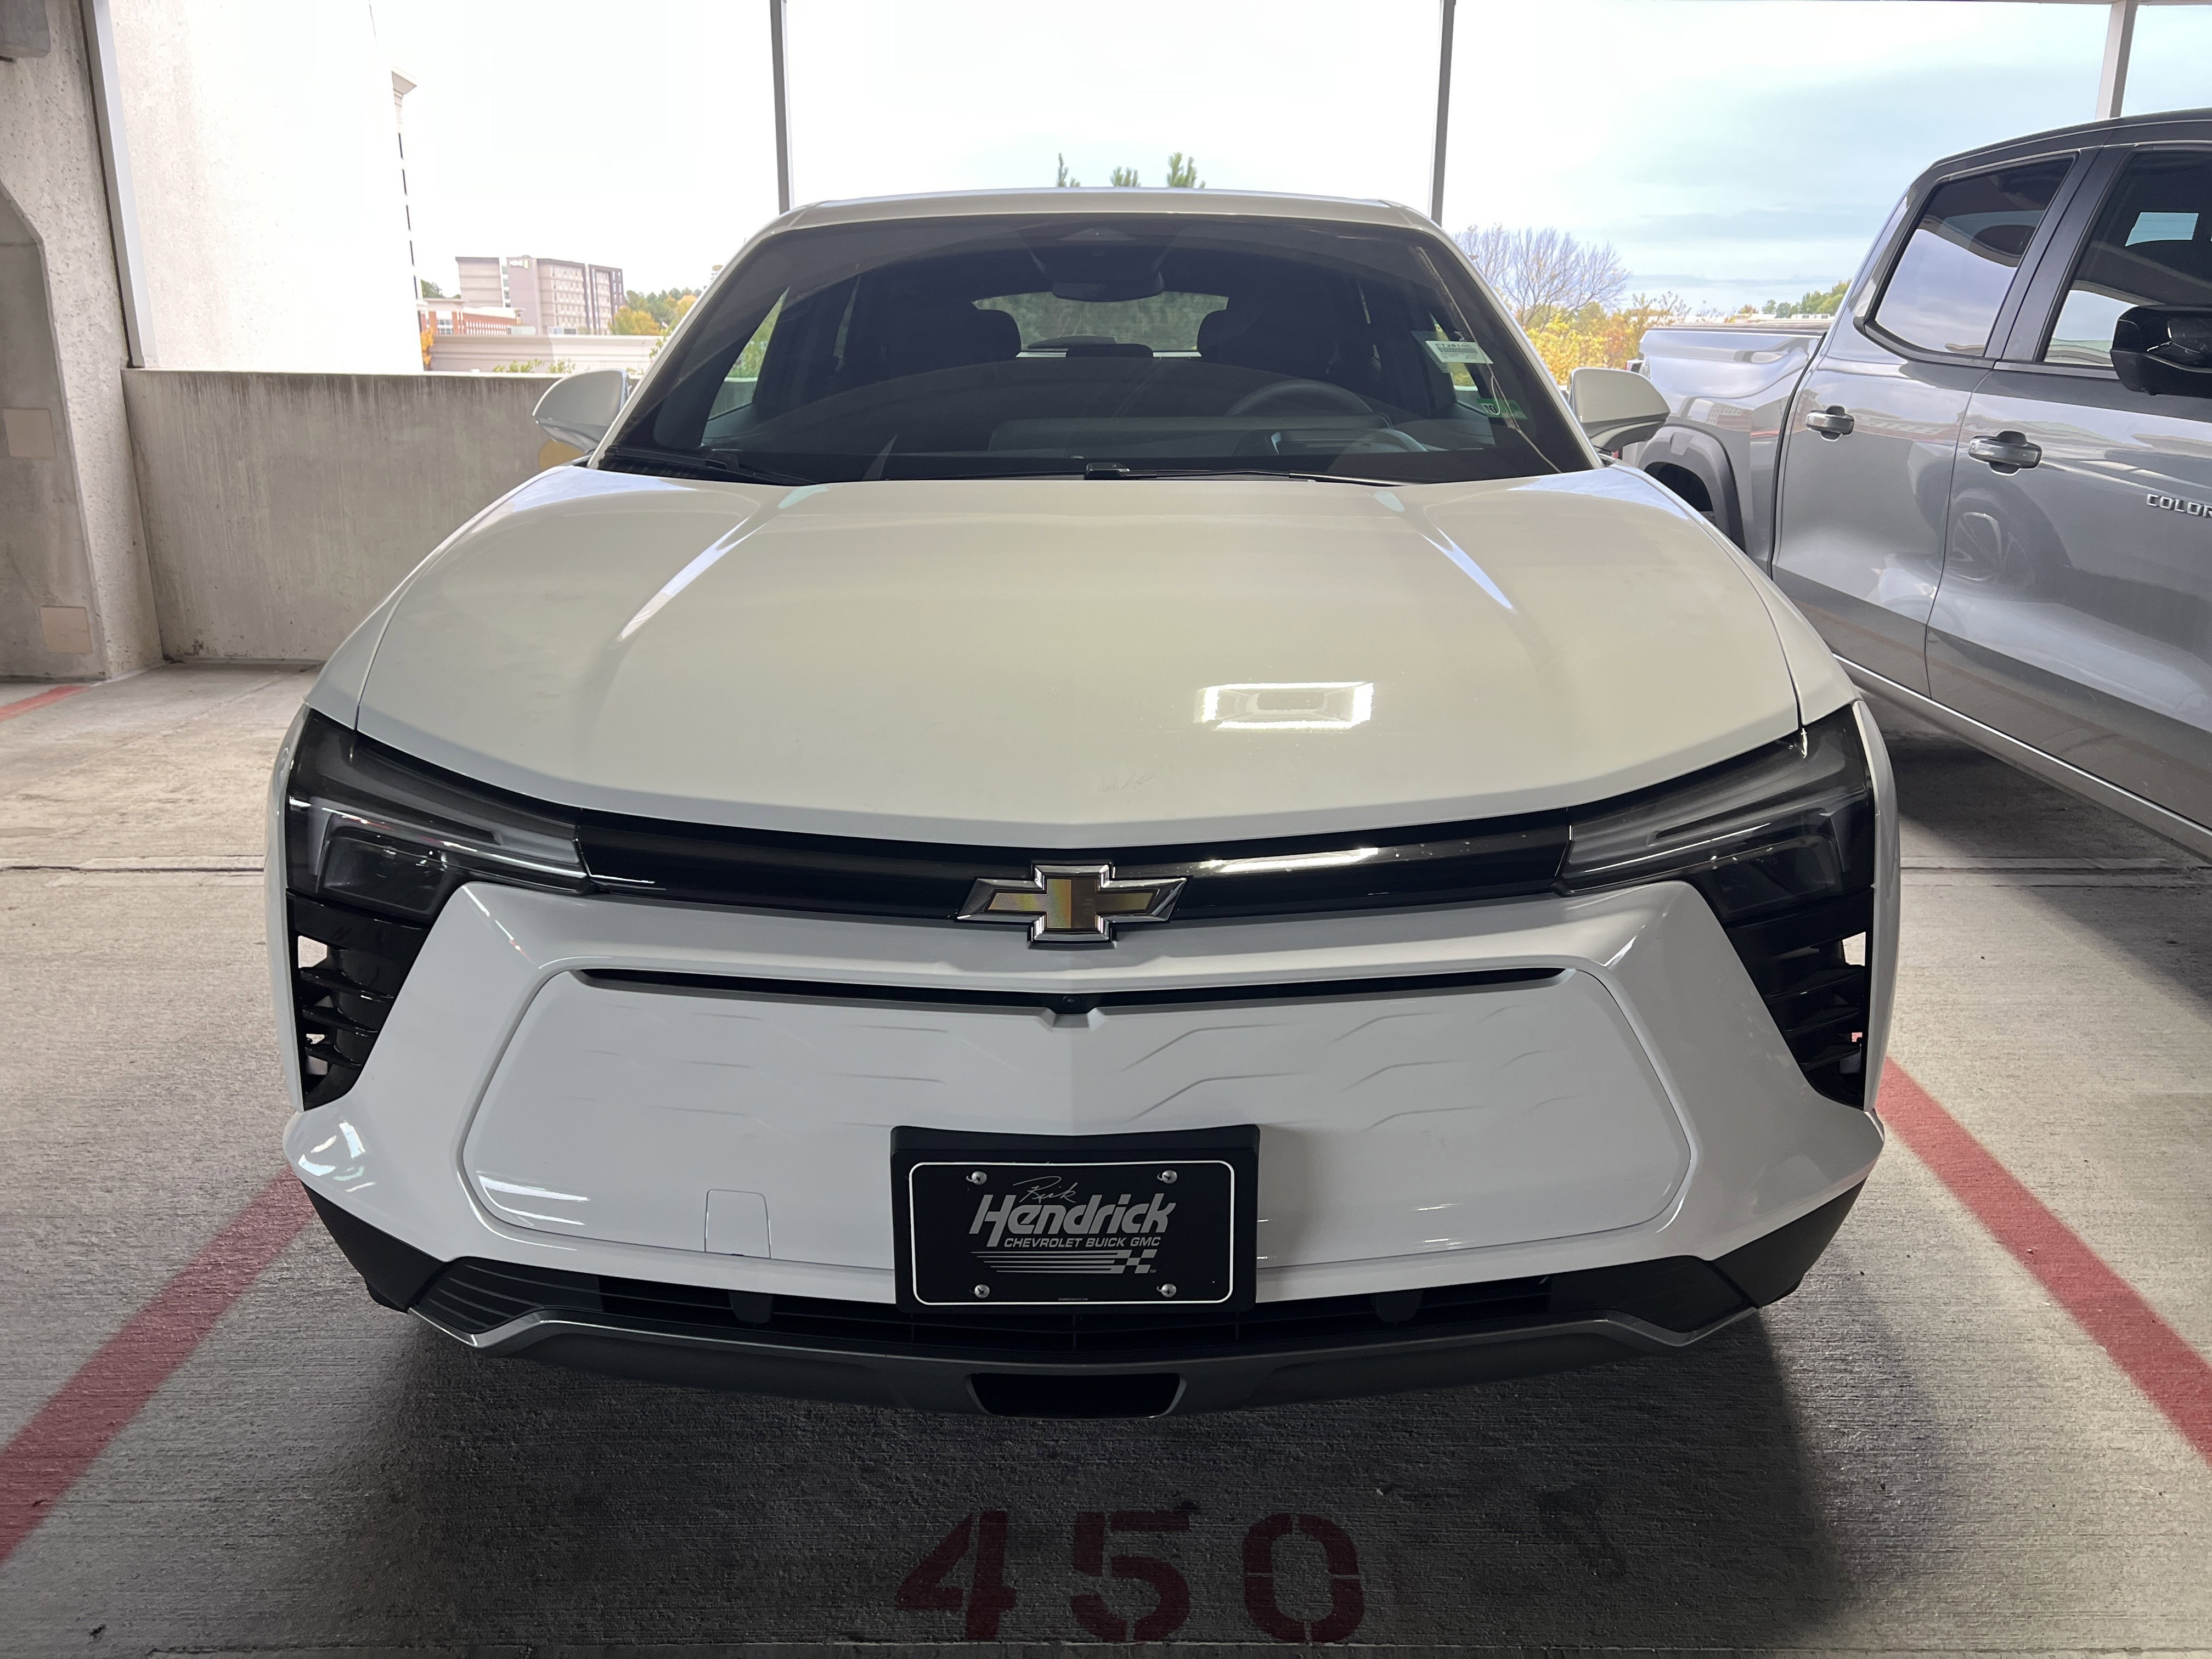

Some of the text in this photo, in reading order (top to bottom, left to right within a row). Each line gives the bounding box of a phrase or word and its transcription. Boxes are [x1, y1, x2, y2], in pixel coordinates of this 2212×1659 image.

[1013, 1176, 1079, 1204] Rick
[969, 1193, 1176, 1248] Hendrick
[1004, 1237, 1161, 1248] CHEVROLET BUICK GMC
[895, 1509, 1365, 1643] 450
